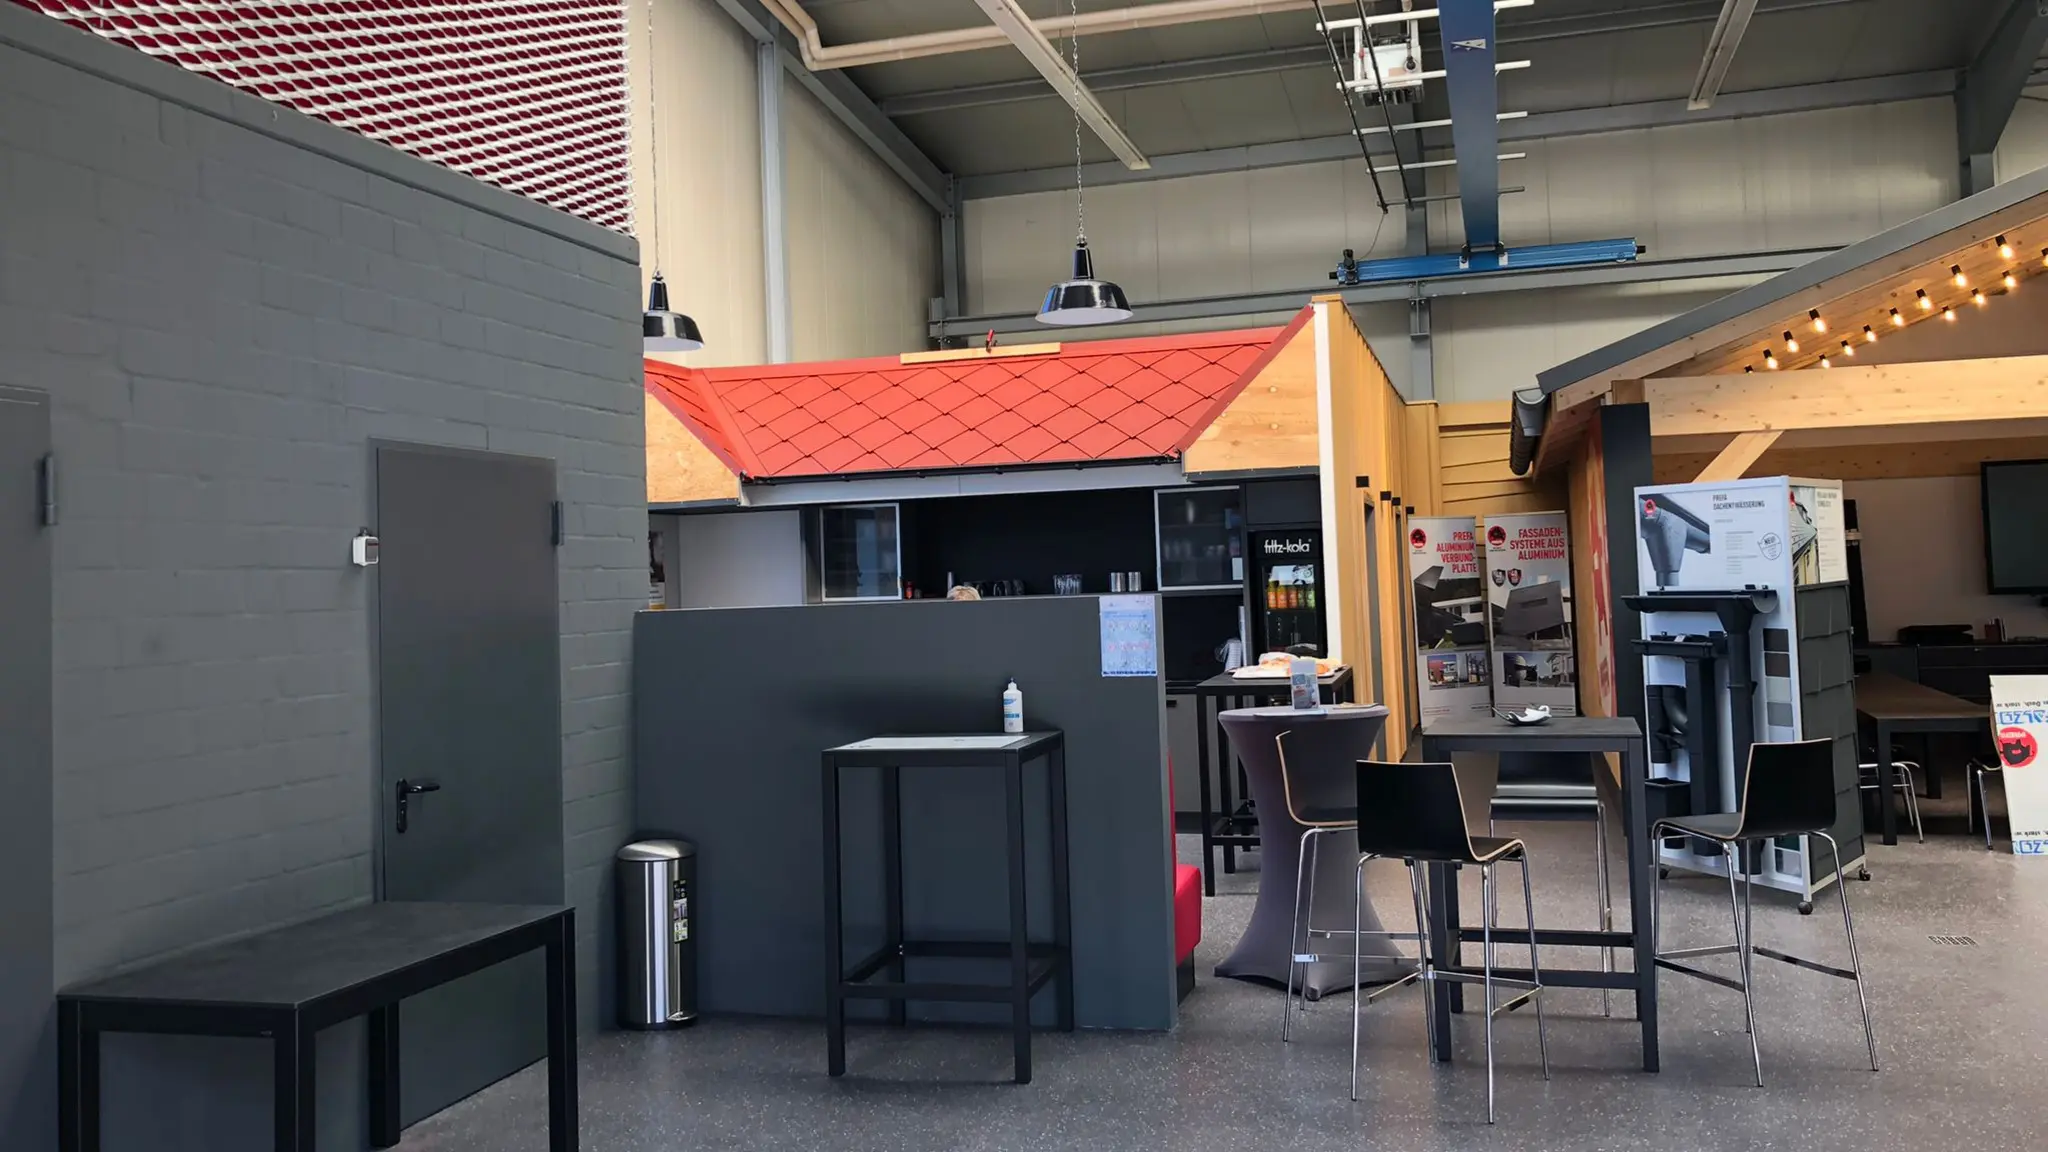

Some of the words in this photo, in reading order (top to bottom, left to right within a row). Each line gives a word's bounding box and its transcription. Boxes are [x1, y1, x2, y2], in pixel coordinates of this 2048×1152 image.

[1453, 531, 1474, 541] PREFA
[1518, 527, 1564, 538] FASSADEN-
[1264, 539, 1310, 554] fritz-kola
[1436, 542, 1475, 552] ALUMINIUM
[1510, 539, 1546, 549] SYSTEME
[1547, 538, 1565, 548] AUS
[1518, 548, 1565, 561] ALUMINIUM
[1452, 563, 1477, 573] PLATTE
